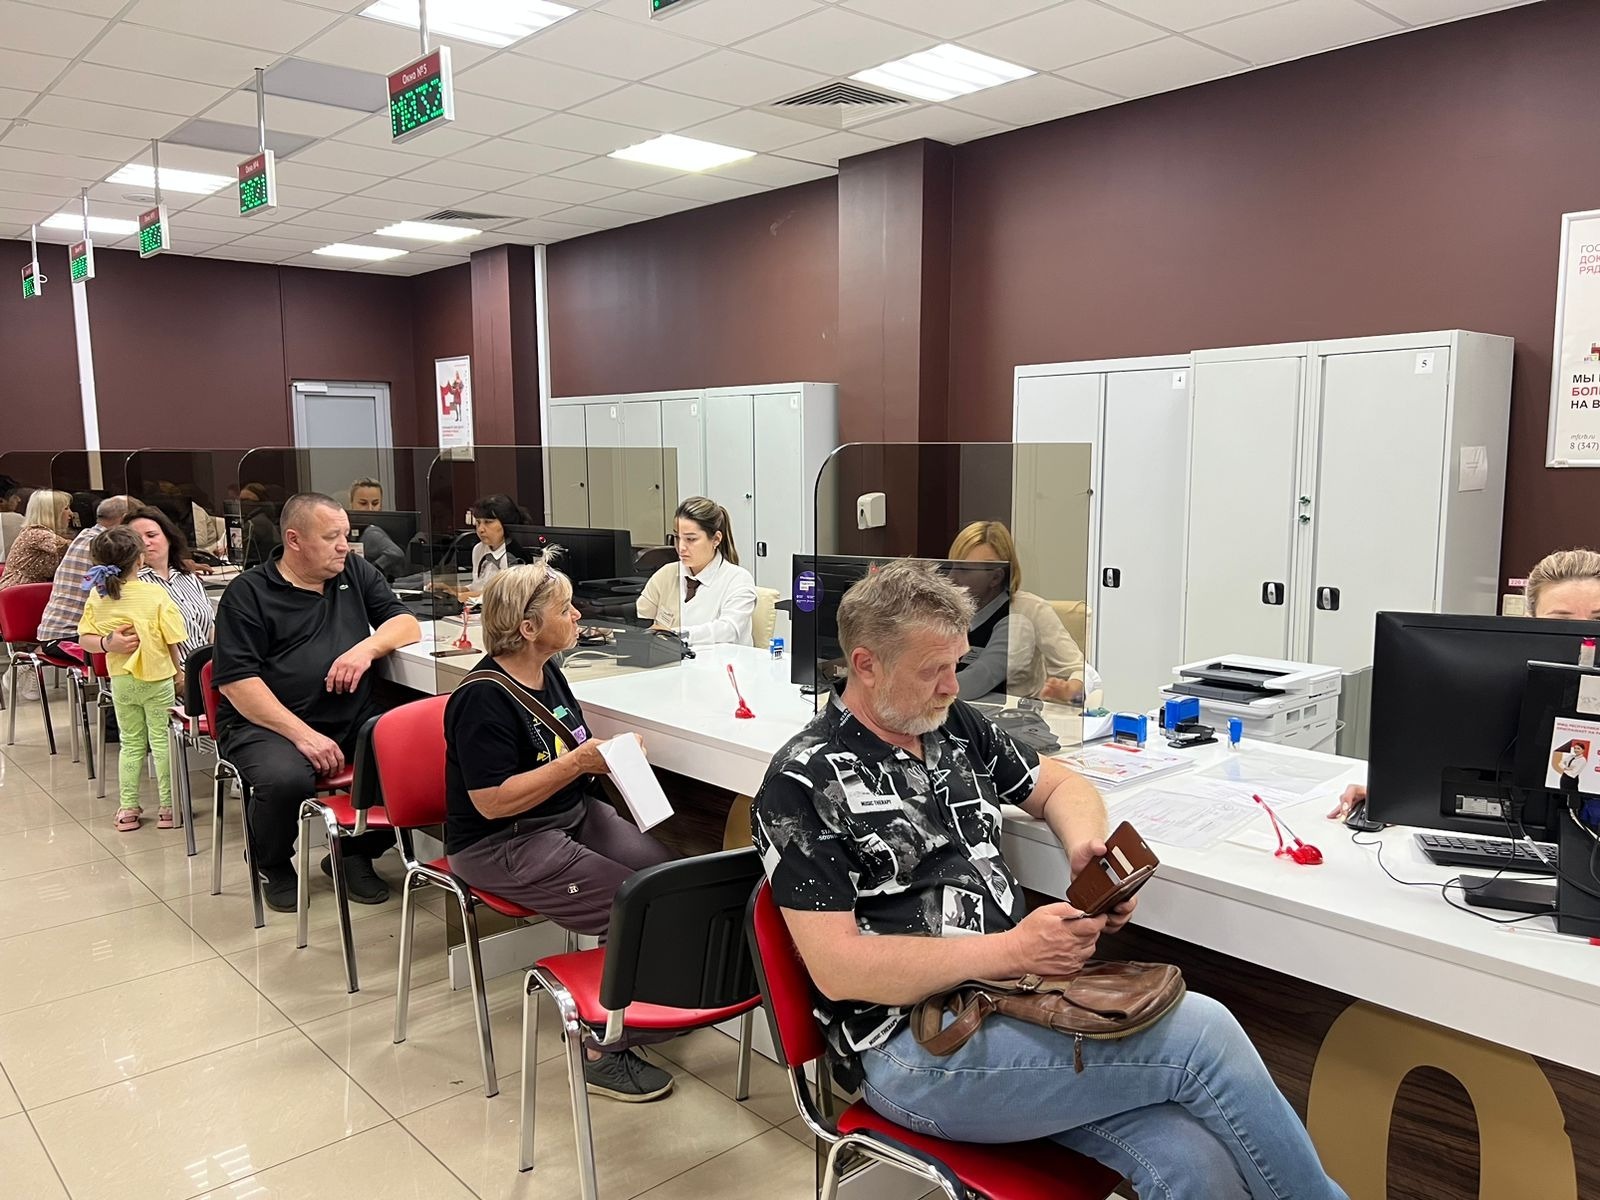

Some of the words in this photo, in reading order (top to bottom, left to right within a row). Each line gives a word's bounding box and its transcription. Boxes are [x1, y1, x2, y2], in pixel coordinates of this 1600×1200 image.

[402, 71, 417, 85] Окно
[416, 63, 428, 77] №5
[1421, 359, 1428, 368] 5
[1572, 374, 1595, 383] МЫ
[1571, 386, 1600, 397] БОЛ
[1570, 400, 1588, 409] НА
